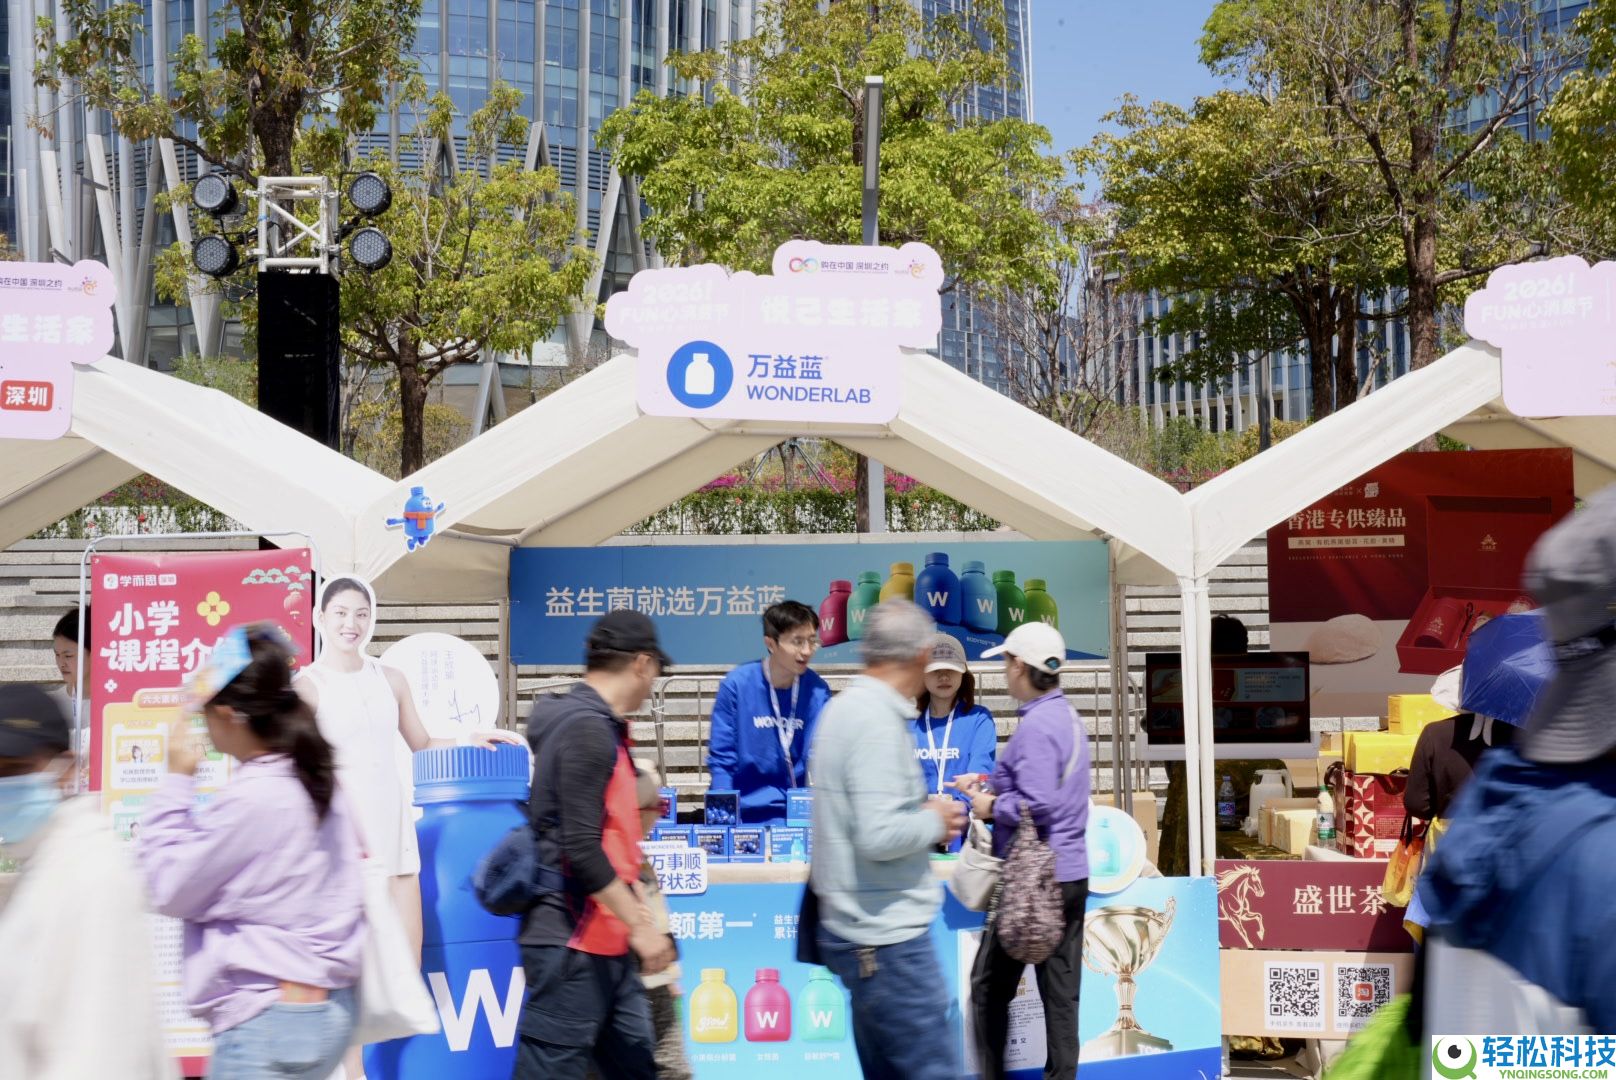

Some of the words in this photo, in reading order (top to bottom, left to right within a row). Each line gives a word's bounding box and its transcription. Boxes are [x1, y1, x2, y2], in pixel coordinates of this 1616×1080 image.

[855, 261, 889, 271] 深圳之约
[30, 278, 62, 288] 深圳之约
[747, 354, 823, 380] 万益蓝
[6, 385, 48, 406] 深圳
[747, 385, 871, 404] WONDERLAB
[1289, 508, 1406, 530] 香港专供臻品
[120, 574, 157, 587] 学而思
[545, 585, 785, 617] 益生菌就选万益蓝
[927, 591, 948, 607] W
[976, 598, 994, 614] W
[109, 600, 180, 636] 小学
[851, 608, 866, 623] W
[1008, 607, 1025, 623] W
[821, 618, 835, 631] W
[100, 637, 224, 672] 课程介
[752, 716, 804, 730] WONDER
[649, 853, 702, 870] 万事顺
[1293, 884, 1387, 916] 盛世茶
[427, 966, 526, 1051] W
[756, 1011, 778, 1029] W
[810, 1010, 832, 1028] W
